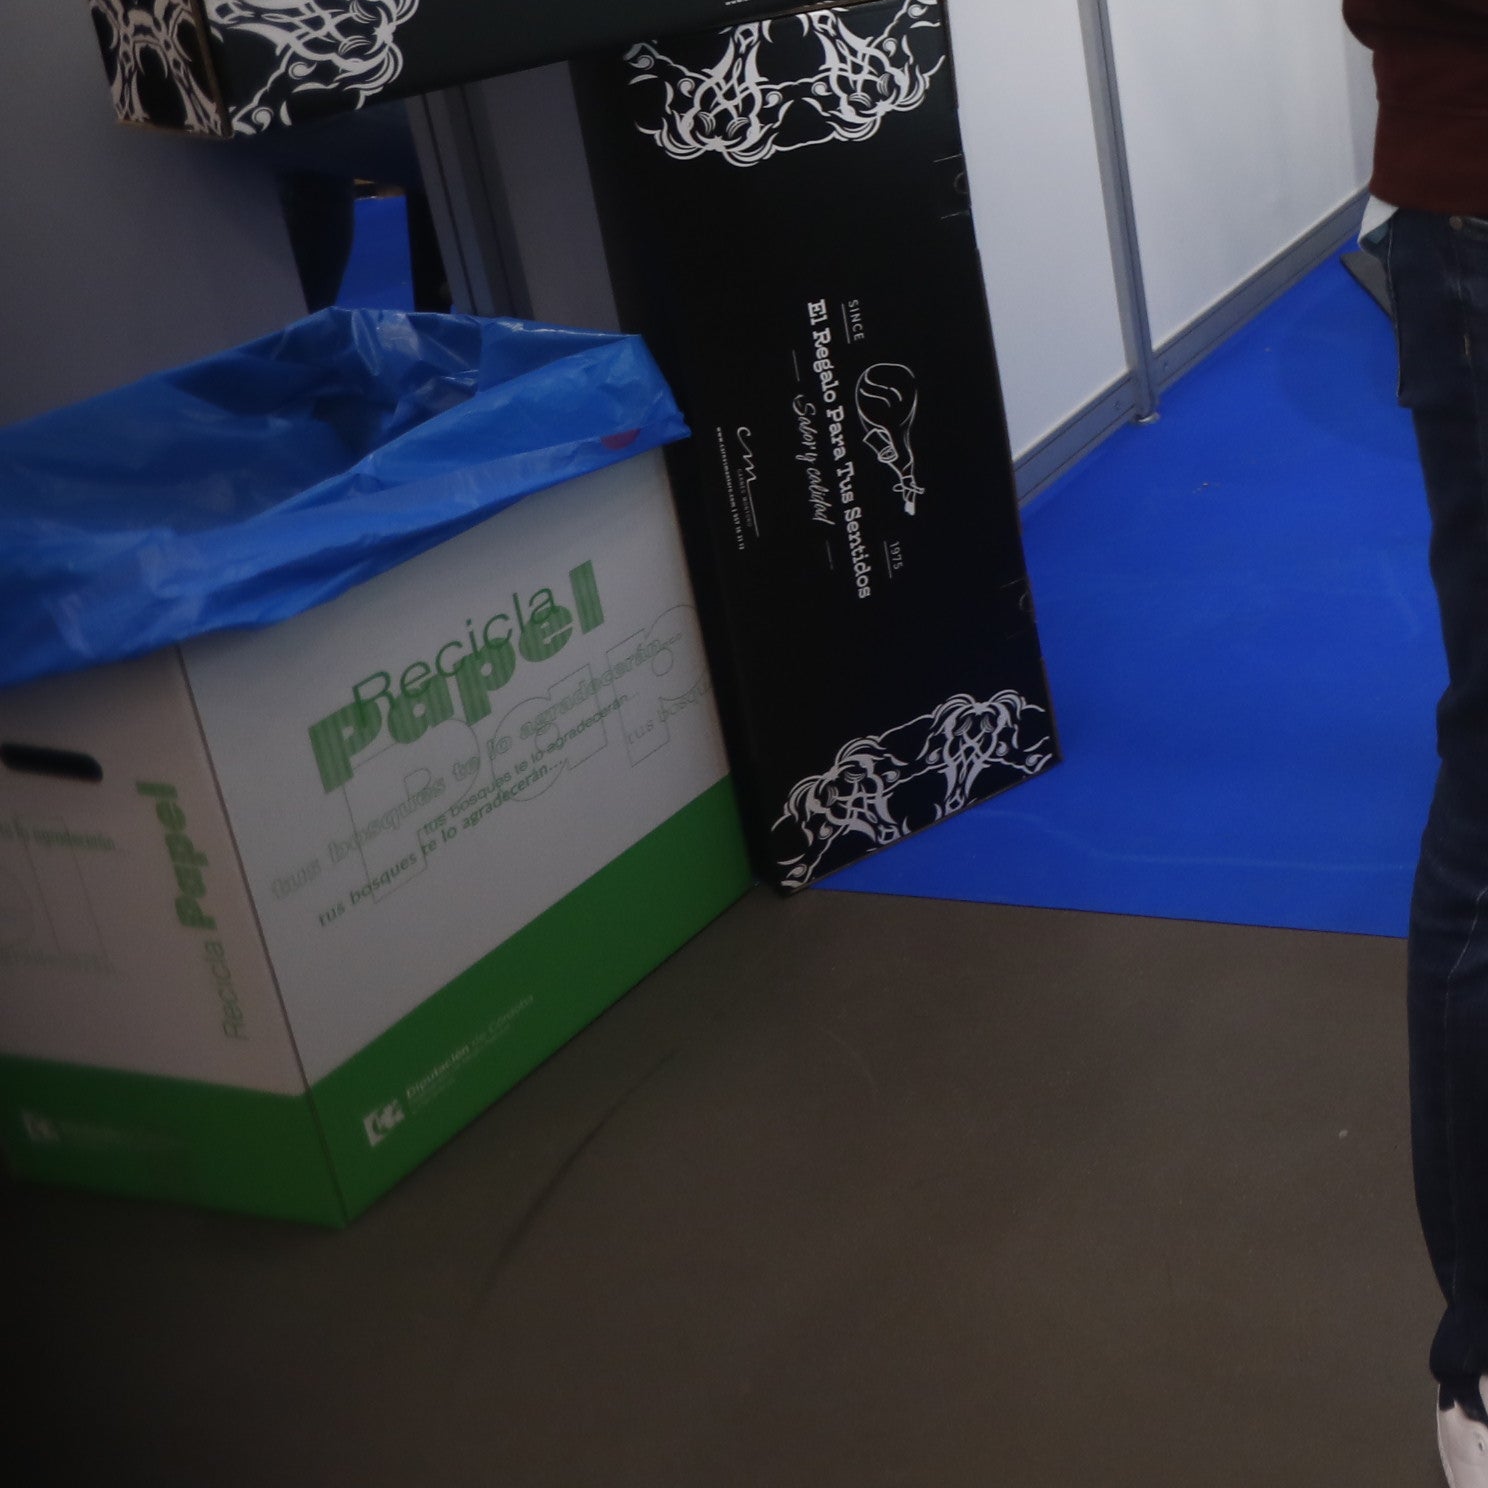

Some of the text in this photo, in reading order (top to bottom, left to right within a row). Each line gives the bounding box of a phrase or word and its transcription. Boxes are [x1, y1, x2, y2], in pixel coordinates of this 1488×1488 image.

[848, 299, 865, 341] SINCE
[792, 394, 835, 526] Sabor y calidad
[807, 299, 871, 599] El Regalo Para Tus Sentidos
[888, 541, 903, 570] 1975
[307, 559, 606, 793] Papel
[351, 585, 556, 711] Recicla
[449, 773, 512, 818] bosques
[530, 748, 545, 764] lo
[135, 780, 219, 932] Papel
[350, 853, 417, 905] bosques
[421, 838, 437, 857] te
[441, 826, 457, 843] lo
[205, 940, 249, 1040] Recicla
